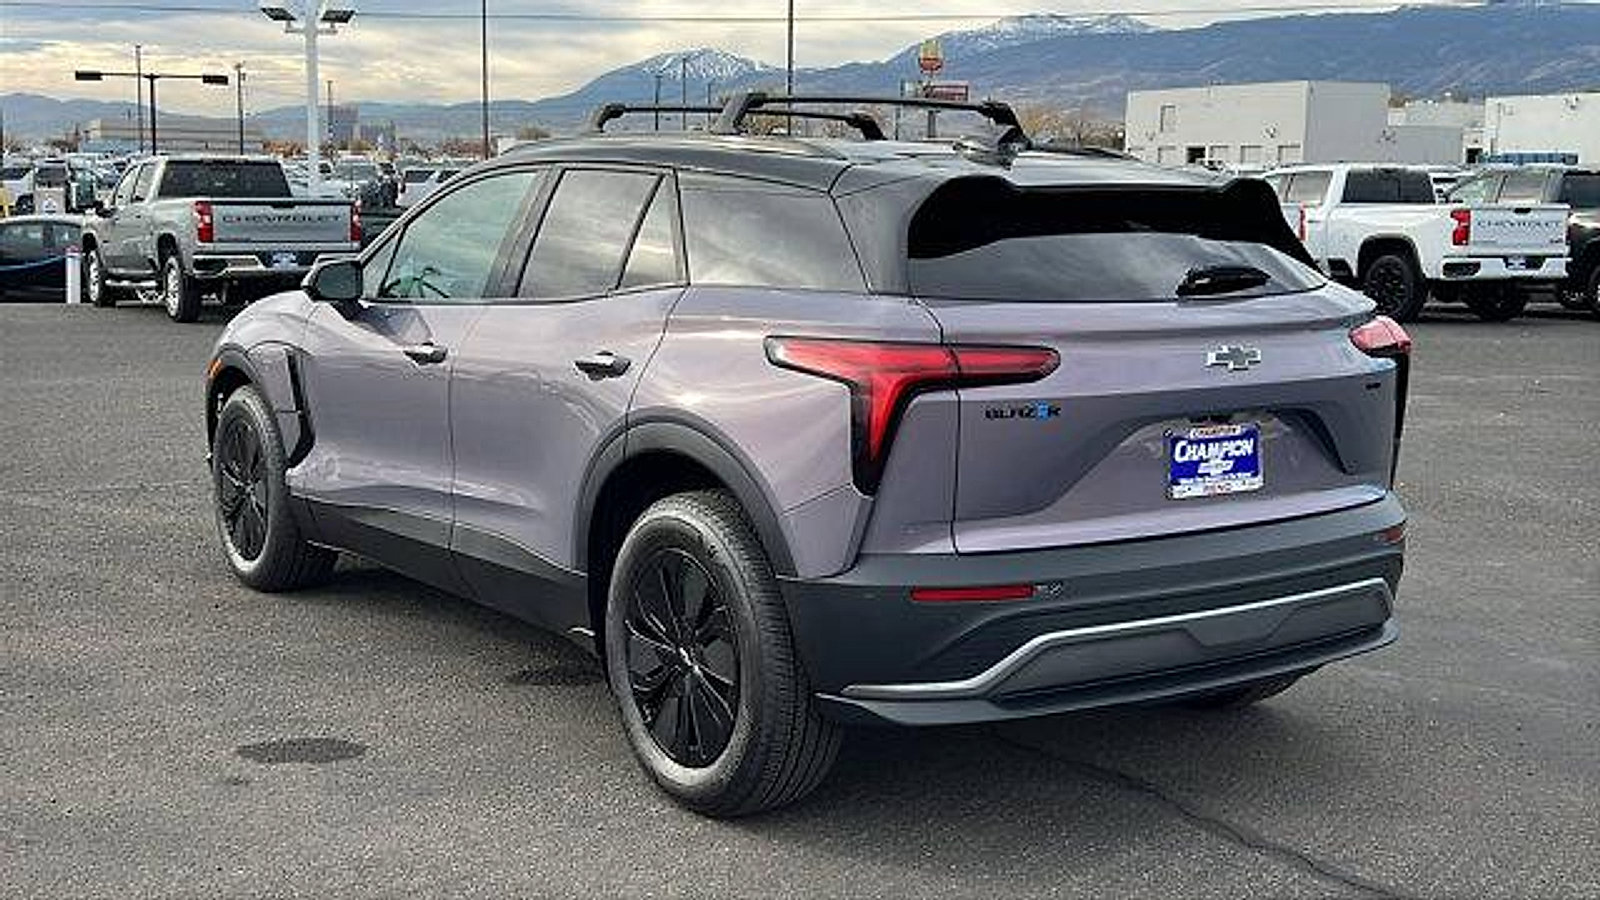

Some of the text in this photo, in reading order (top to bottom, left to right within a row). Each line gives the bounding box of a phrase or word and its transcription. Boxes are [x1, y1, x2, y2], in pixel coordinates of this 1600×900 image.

[222, 213, 340, 222] CHEVROLET
[1476, 219, 1561, 229] CHEVROLET
[985, 403, 1062, 419] BLAZER
[1174, 438, 1255, 463] CHAMPION
